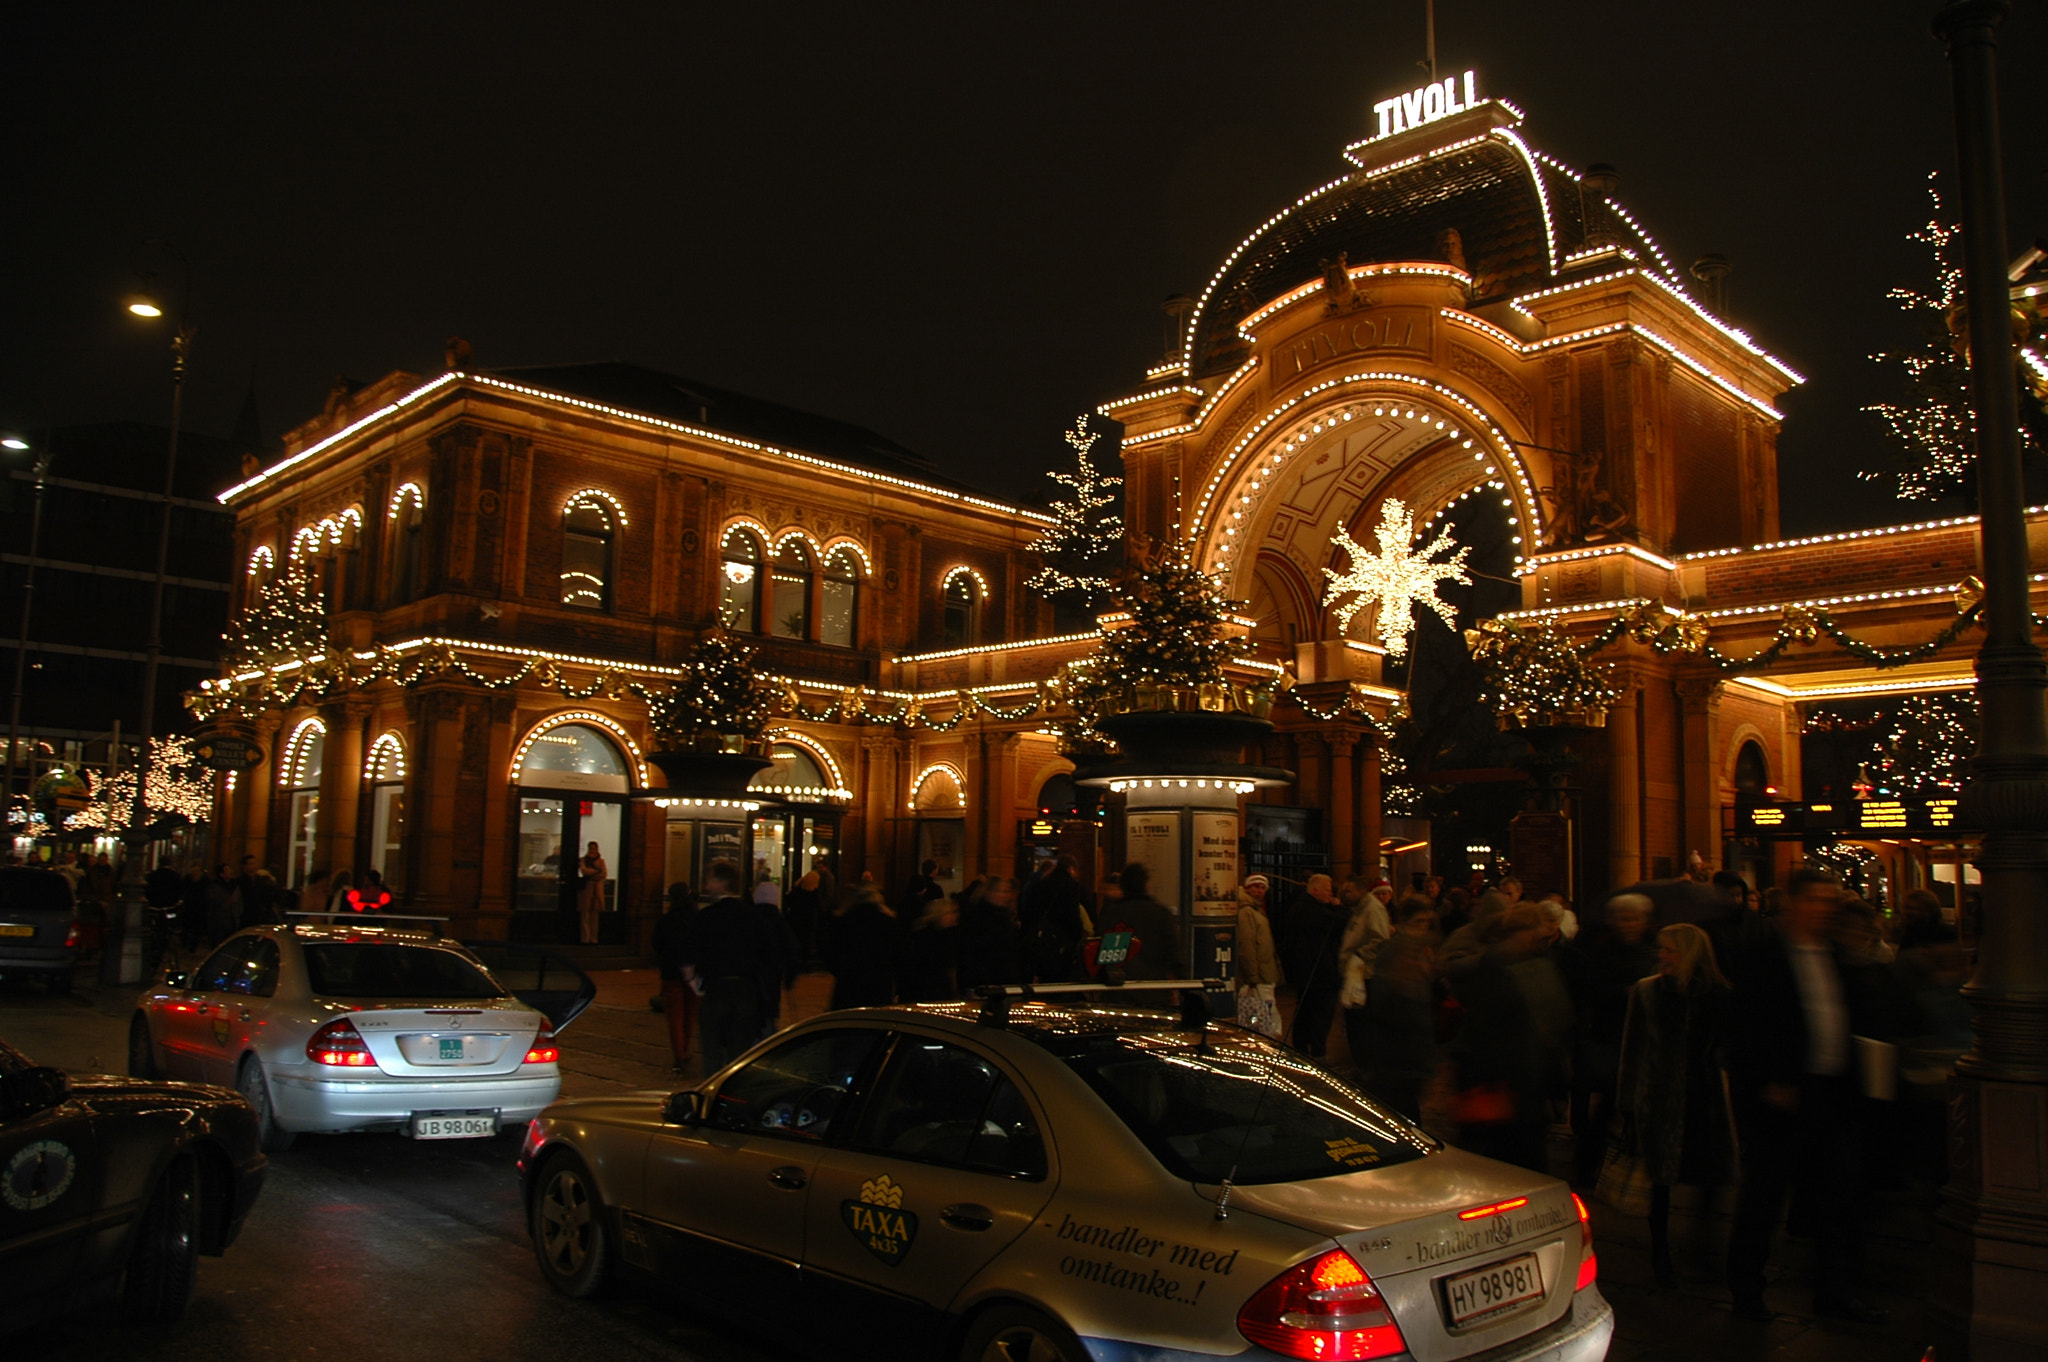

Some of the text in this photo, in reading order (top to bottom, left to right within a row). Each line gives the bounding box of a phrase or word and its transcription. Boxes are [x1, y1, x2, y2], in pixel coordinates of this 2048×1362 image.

[1374, 70, 1475, 139] TIVOLI
[1284, 317, 1413, 372] TIVOLI
[1143, 825, 1169, 833] TIVOLI
[1098, 948, 1127, 963] 0960
[1114, 935, 1120, 948] 1
[419, 1122, 440, 1135] JB
[849, 1205, 909, 1242] TAXA
[868, 1235, 899, 1255] 4x35
[1169, 1244, 1239, 1276] med
[1060, 1255, 1206, 1306] omtanke..!
[1453, 1262, 1535, 1314] HY 98981
